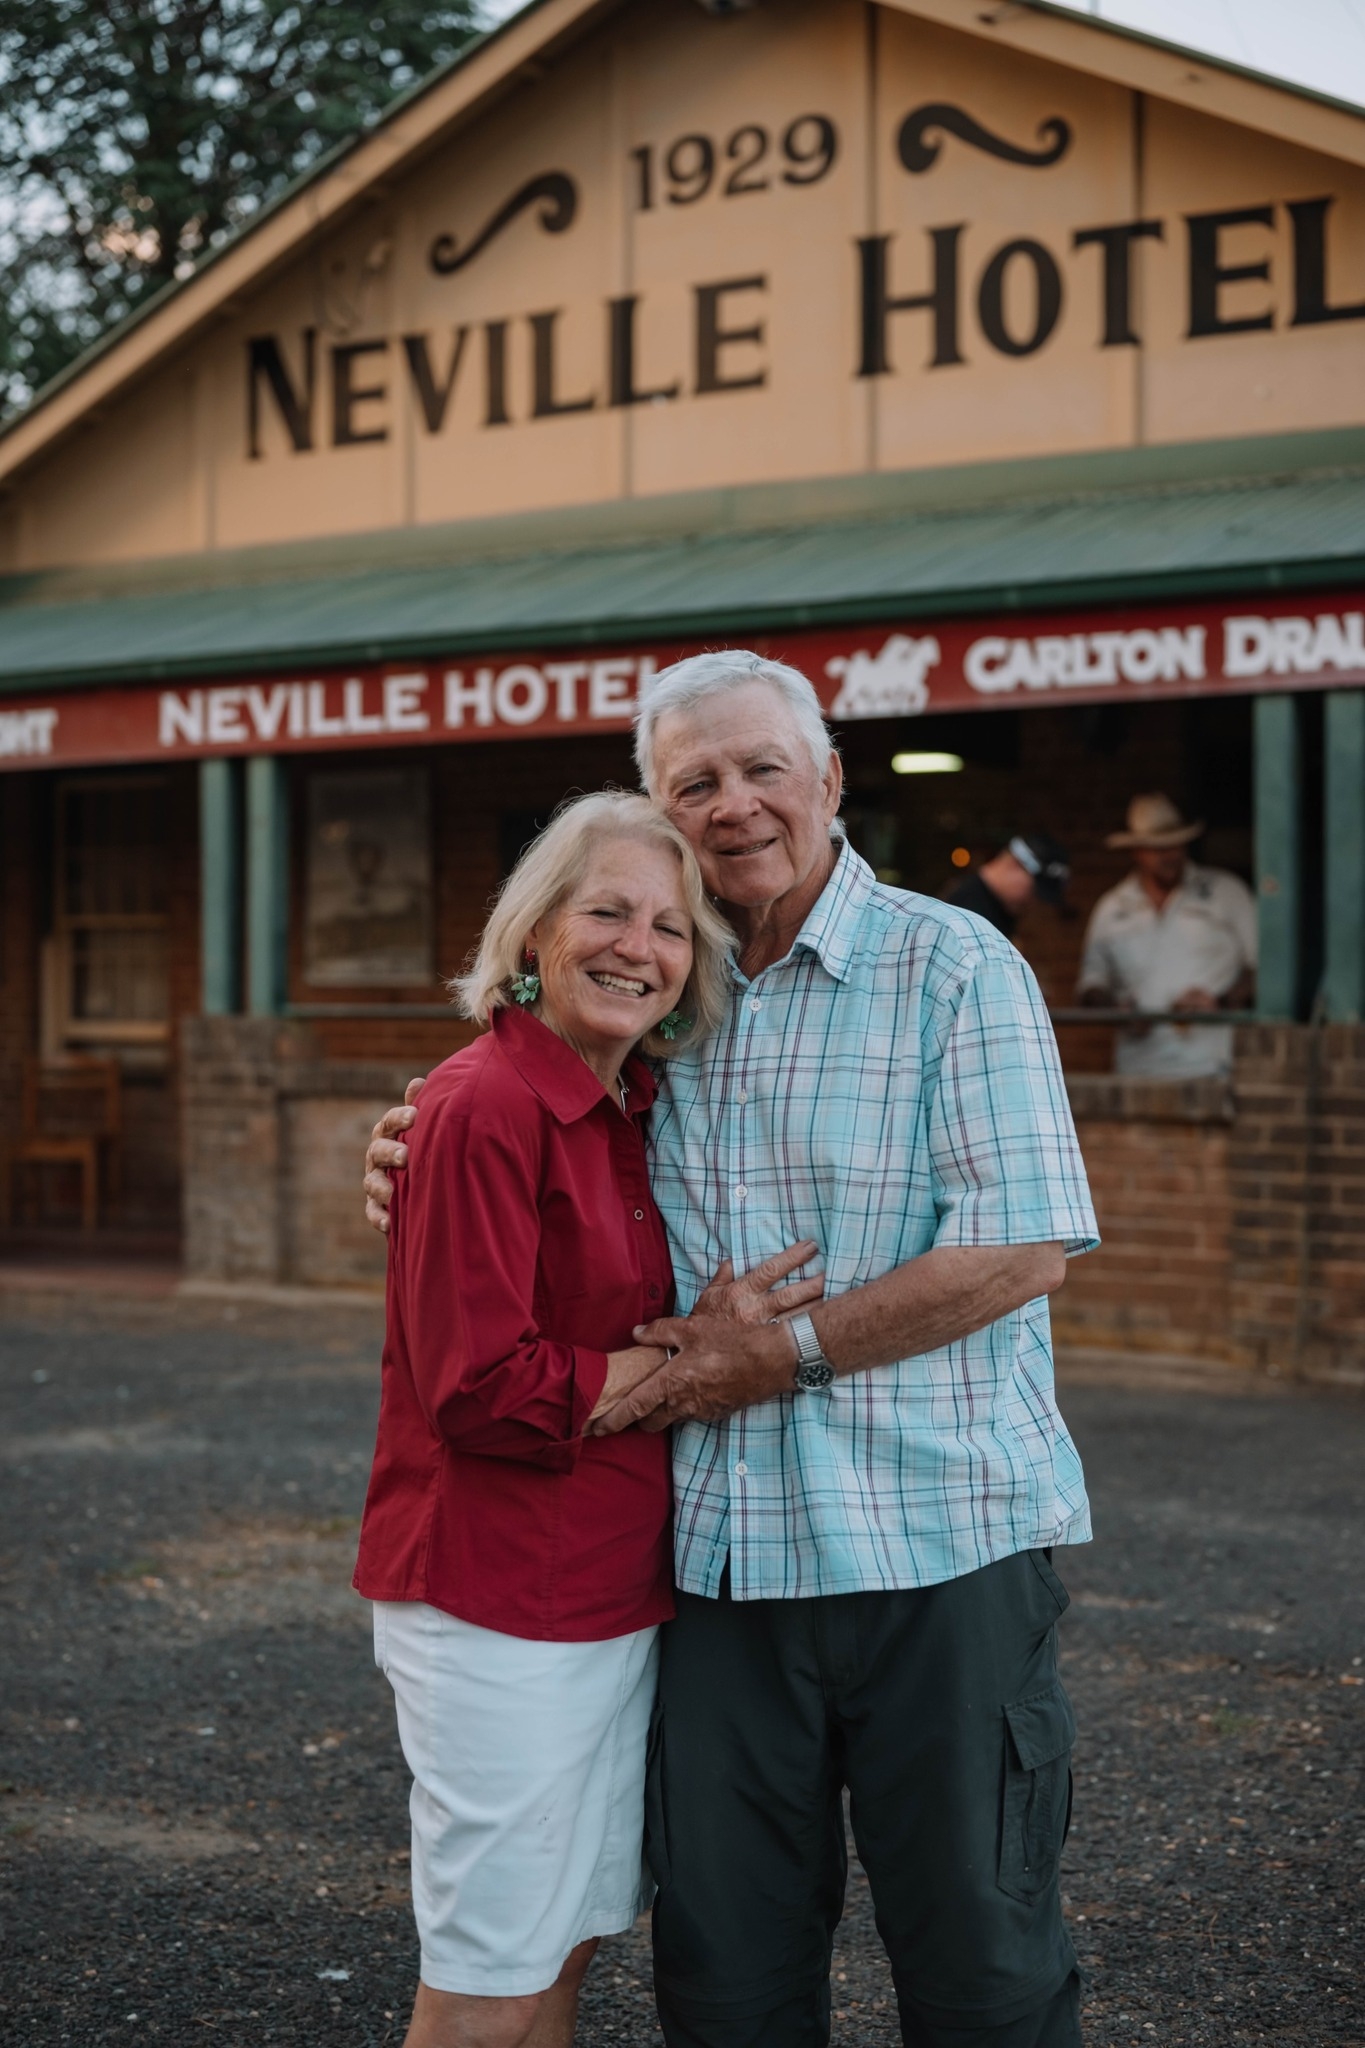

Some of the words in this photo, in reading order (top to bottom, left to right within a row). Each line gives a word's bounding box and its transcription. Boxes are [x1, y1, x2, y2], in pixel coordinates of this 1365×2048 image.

[629, 113, 839, 213] 1929
[245, 273, 769, 461] NEVILLE
[852, 194, 1365, 380] HOTEL
[963, 626, 1207, 694] CARLTON
[159, 671, 428, 746] NEVILLE
